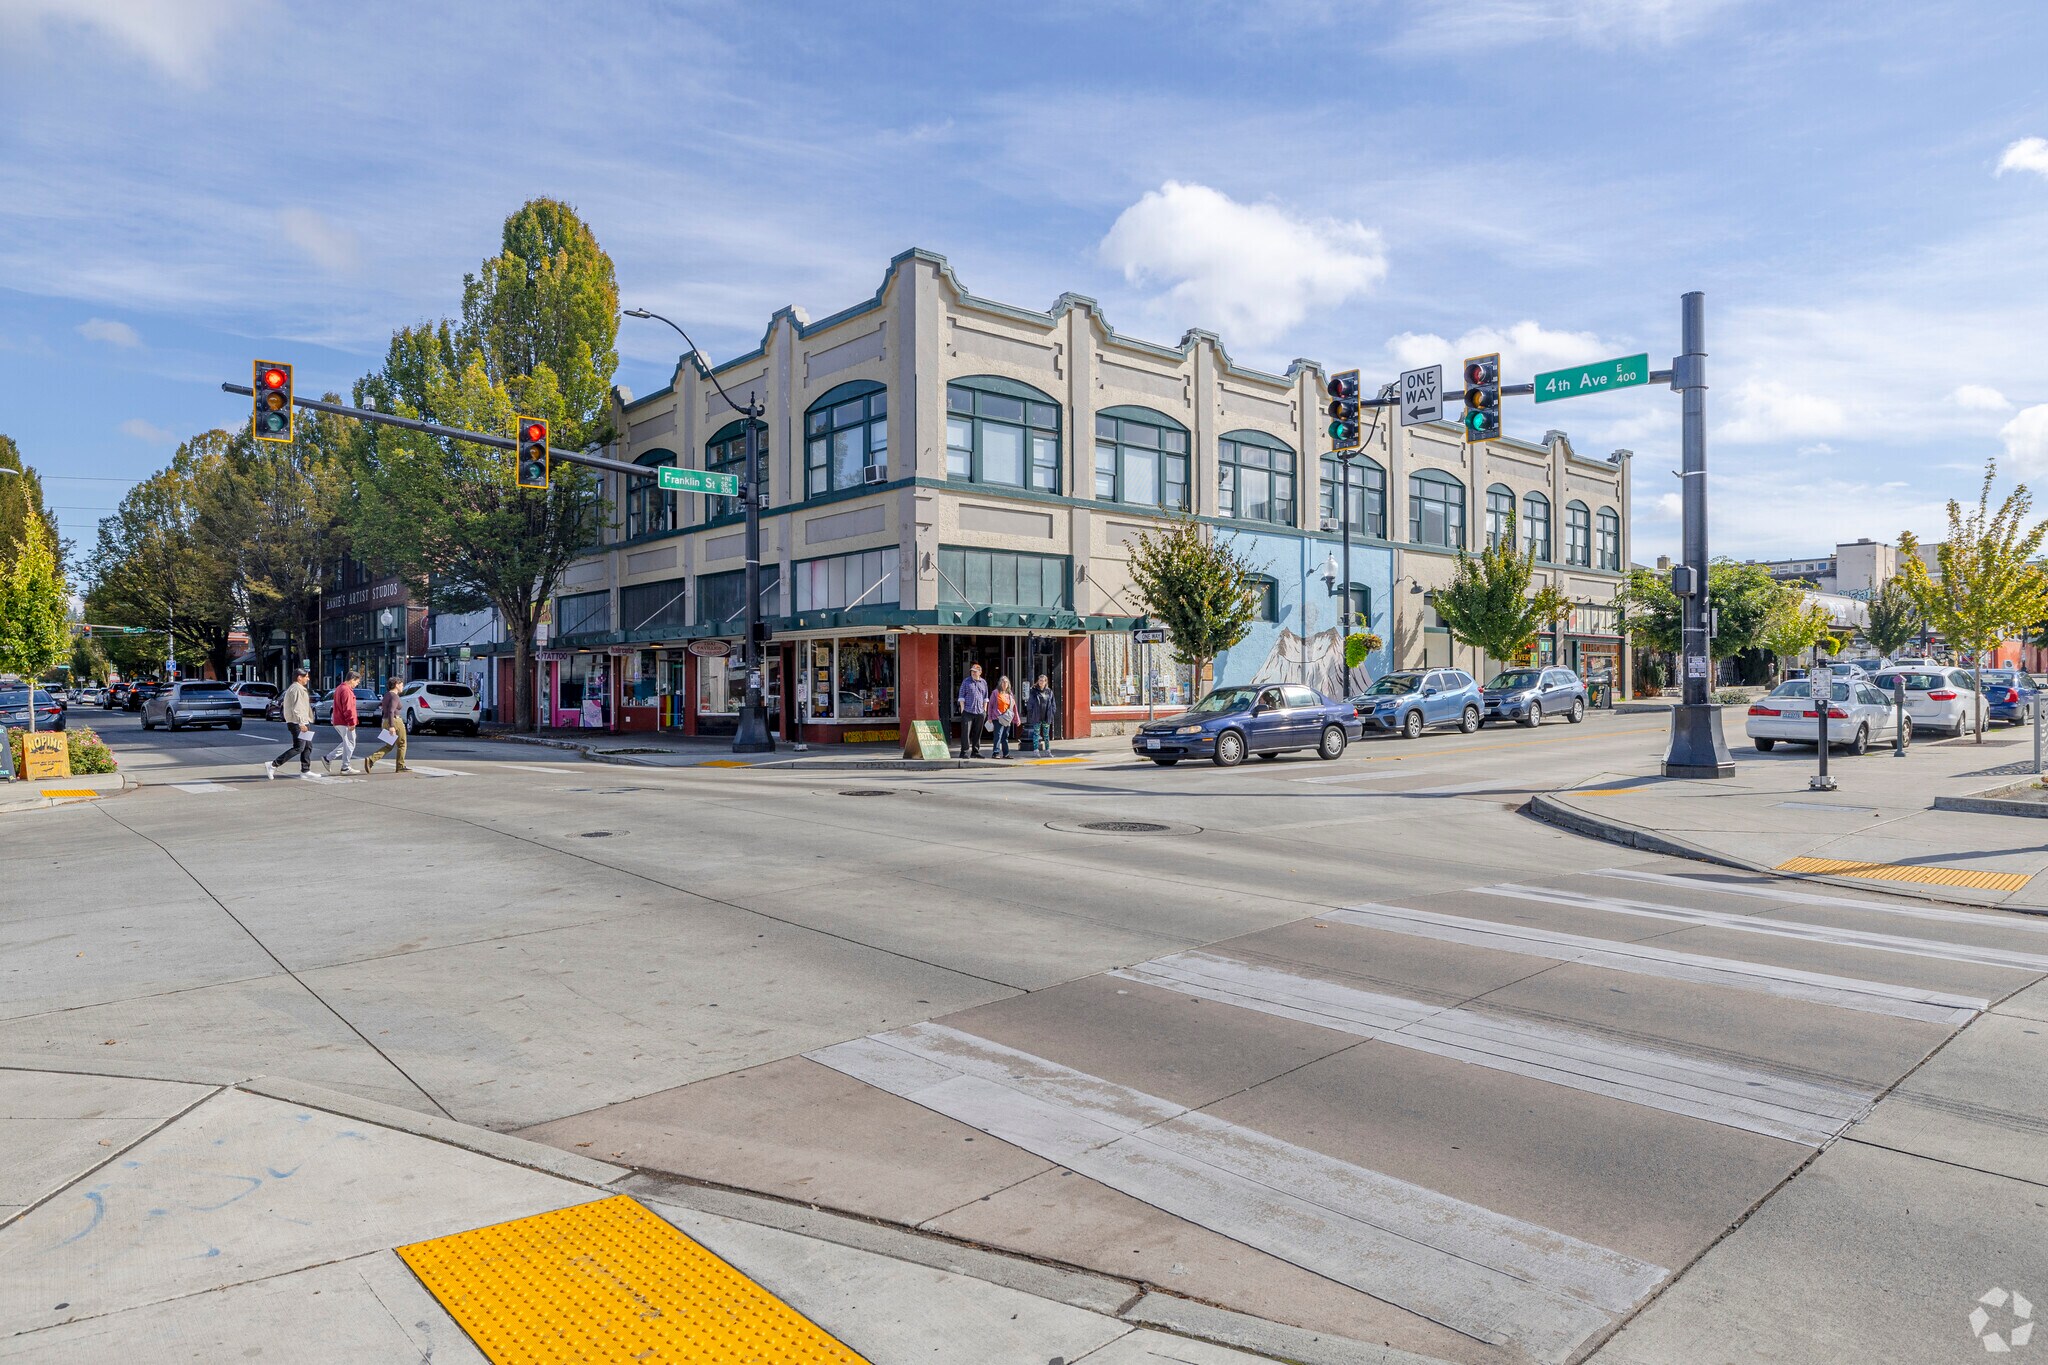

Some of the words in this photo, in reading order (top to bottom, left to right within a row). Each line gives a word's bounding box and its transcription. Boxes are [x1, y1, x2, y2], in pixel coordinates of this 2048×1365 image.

[1616, 363, 1622, 373] E
[1616, 372, 1636, 383] 400
[1407, 370, 1435, 389] ONE
[1545, 377, 1570, 393] 4th
[1579, 372, 1607, 389] Ave
[1405, 386, 1436, 405] WAY
[664, 471, 700, 487] Franklin
[705, 477, 716, 489] St
[348, 589, 369, 605] ARTIST
[372, 583, 398, 600] STUDIOS
[1576, 608, 1614, 629] PIZZA
[543, 652, 568, 660] TATTOO
